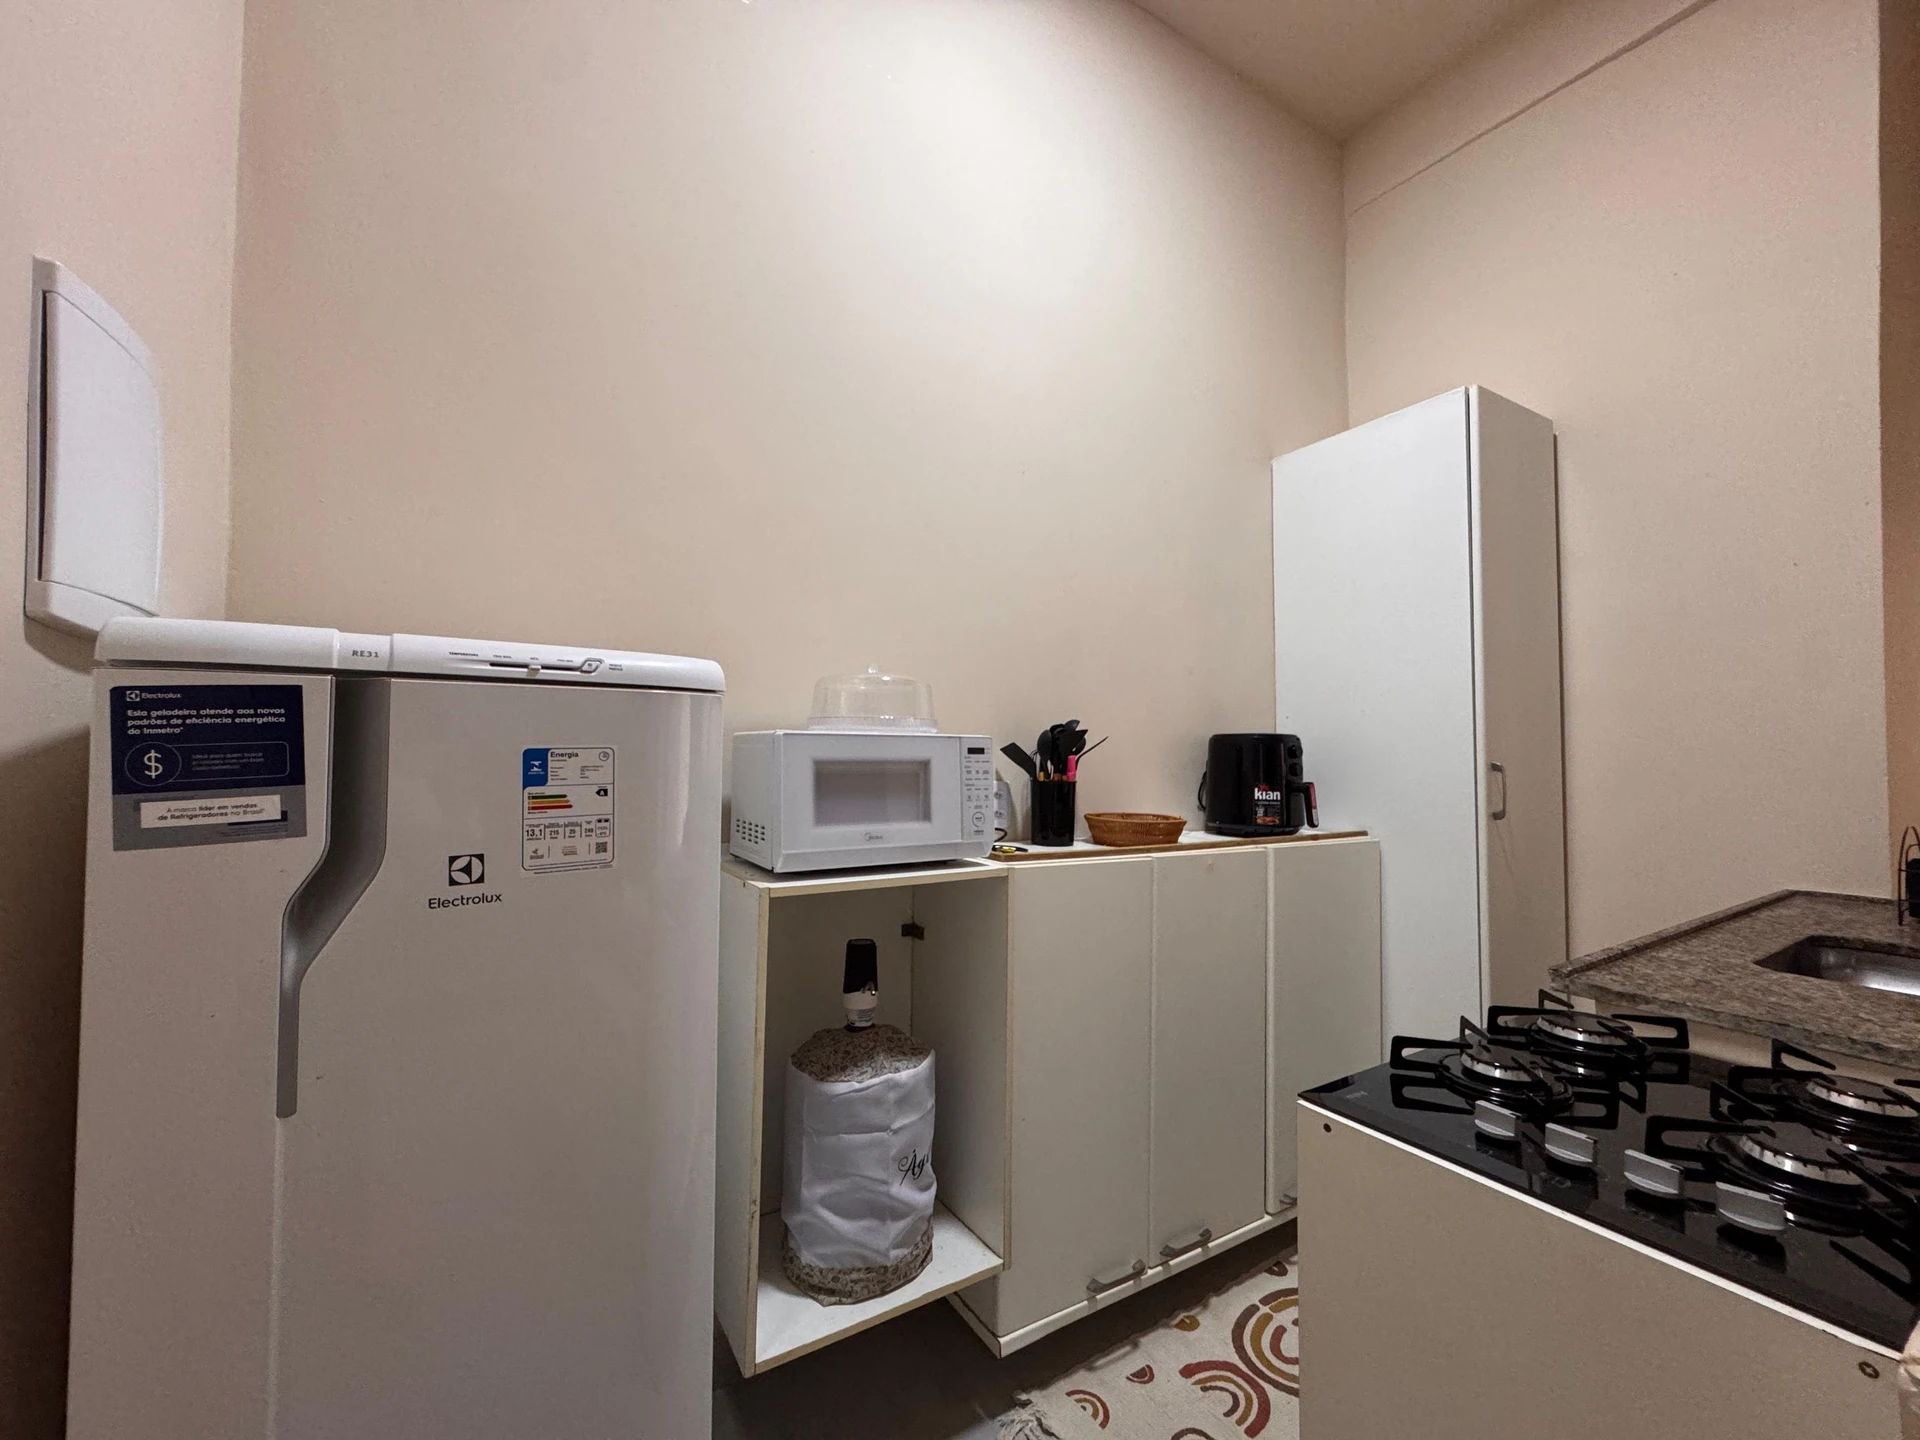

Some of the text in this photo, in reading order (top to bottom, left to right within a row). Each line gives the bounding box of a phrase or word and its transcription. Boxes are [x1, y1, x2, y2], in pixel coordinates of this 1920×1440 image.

[351, 649, 379, 658] RE31
[127, 709, 148, 717] Esta
[150, 709, 197, 718] geladeira
[127, 715, 286, 727] padrões de eficiência energética
[127, 727, 141, 735] do
[550, 751, 579, 759] Energia
[1254, 787, 1281, 801] kian
[170, 812, 229, 820] Refrigeradores
[428, 893, 502, 909] Electrolux
